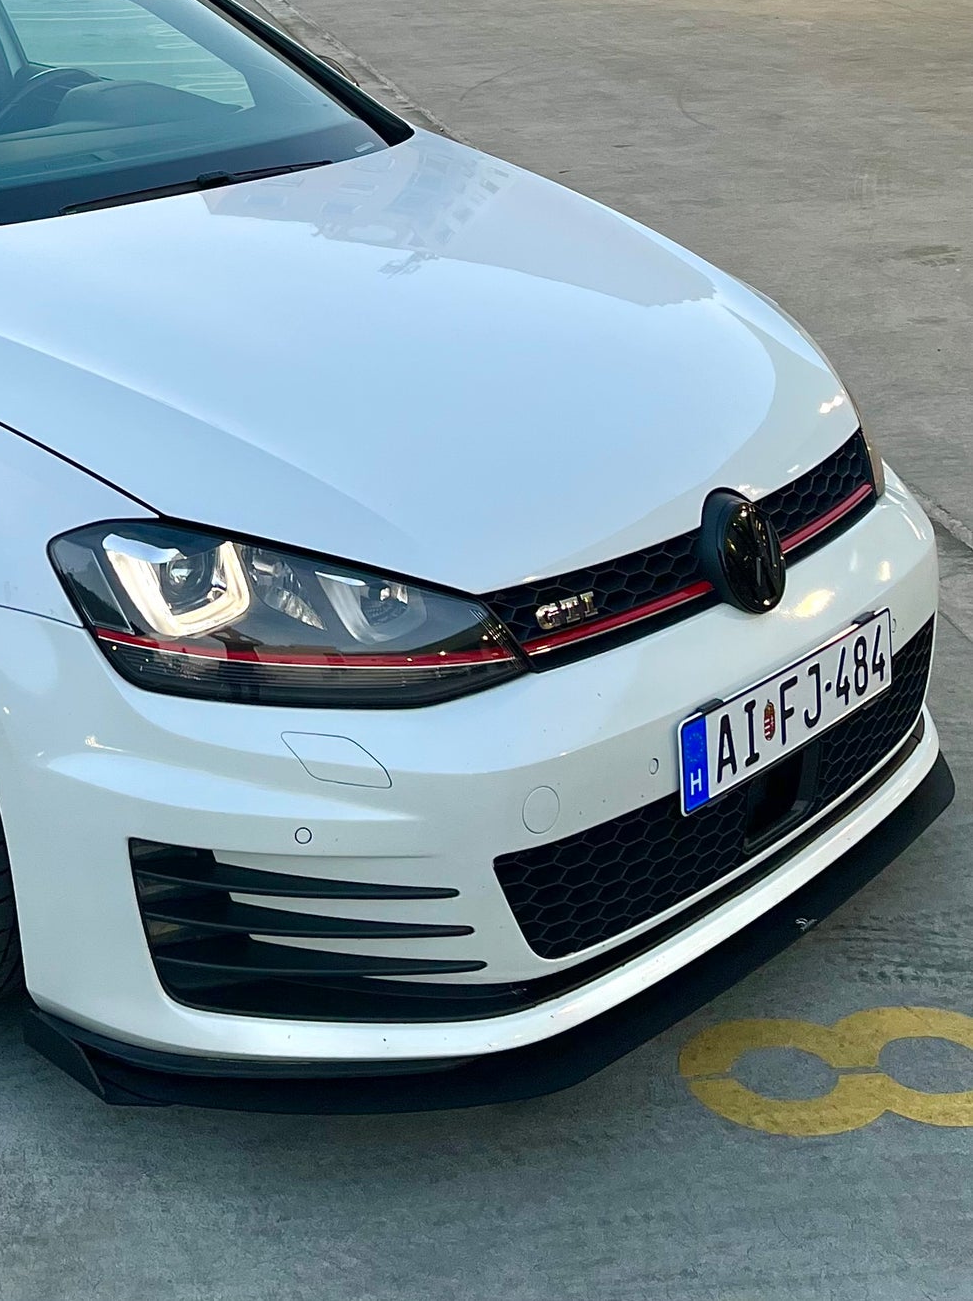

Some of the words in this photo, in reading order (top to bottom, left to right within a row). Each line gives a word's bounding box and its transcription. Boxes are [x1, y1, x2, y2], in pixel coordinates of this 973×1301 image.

[535, 591, 598, 630] GTI
[717, 699, 760, 784] AI
[780, 625, 886, 746] FJ-484
[690, 768, 703, 796] H
